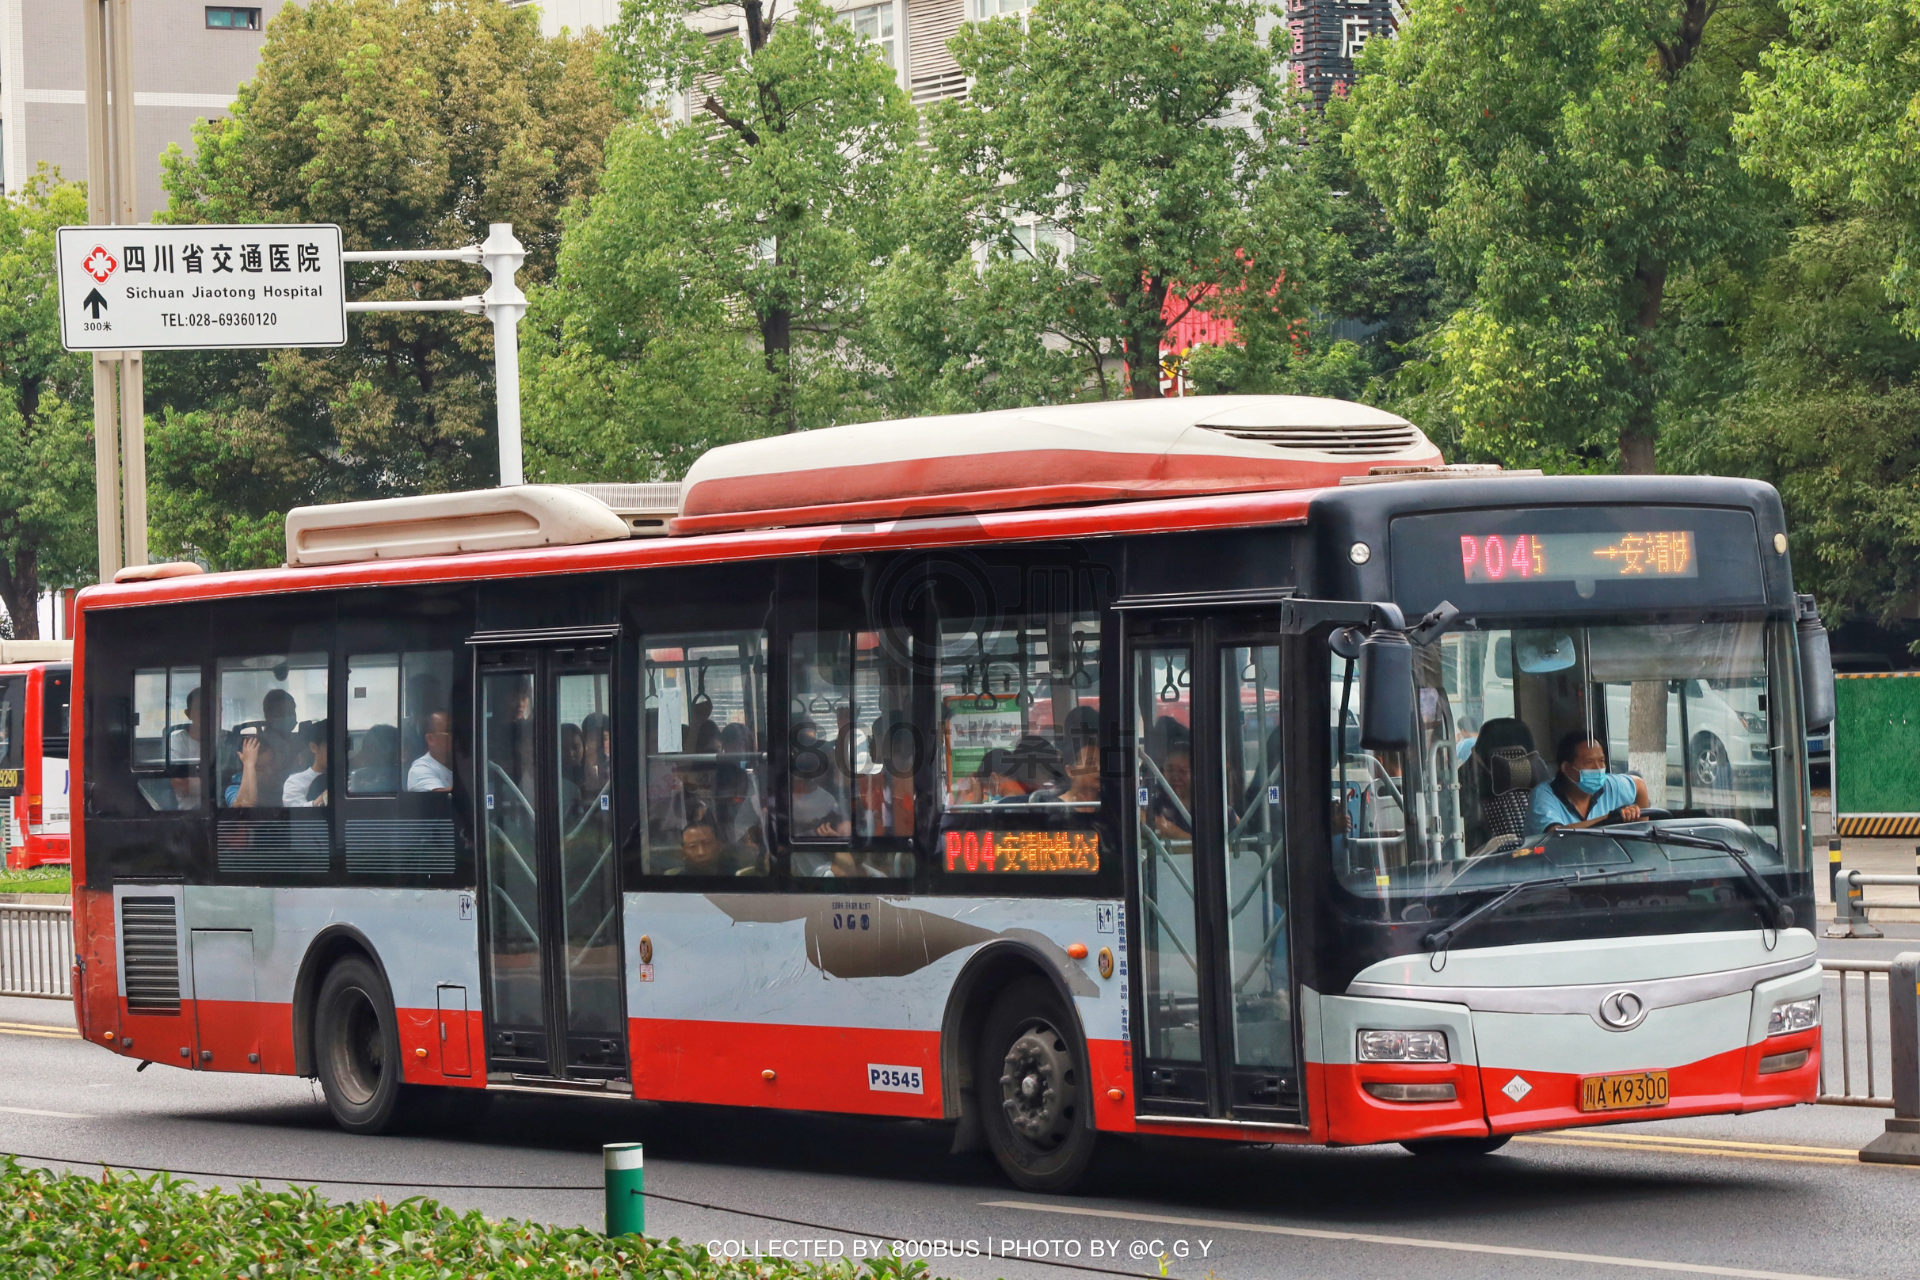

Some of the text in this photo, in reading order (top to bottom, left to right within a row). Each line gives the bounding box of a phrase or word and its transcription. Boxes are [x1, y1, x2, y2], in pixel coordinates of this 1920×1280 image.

[1341, 0, 1370, 58] 店
[123, 242, 321, 274] 四川省交通医院
[126, 285, 323, 300] Sichuan Jiaotong Hospital
[83, 322, 112, 332] 300米
[161, 312, 278, 327] TEL:028-69360120
[1461, 535, 1530, 577] P04
[945, 831, 995, 871] P04
[870, 1069, 920, 1088] P3545
[1507, 1083, 1526, 1094] CNG
